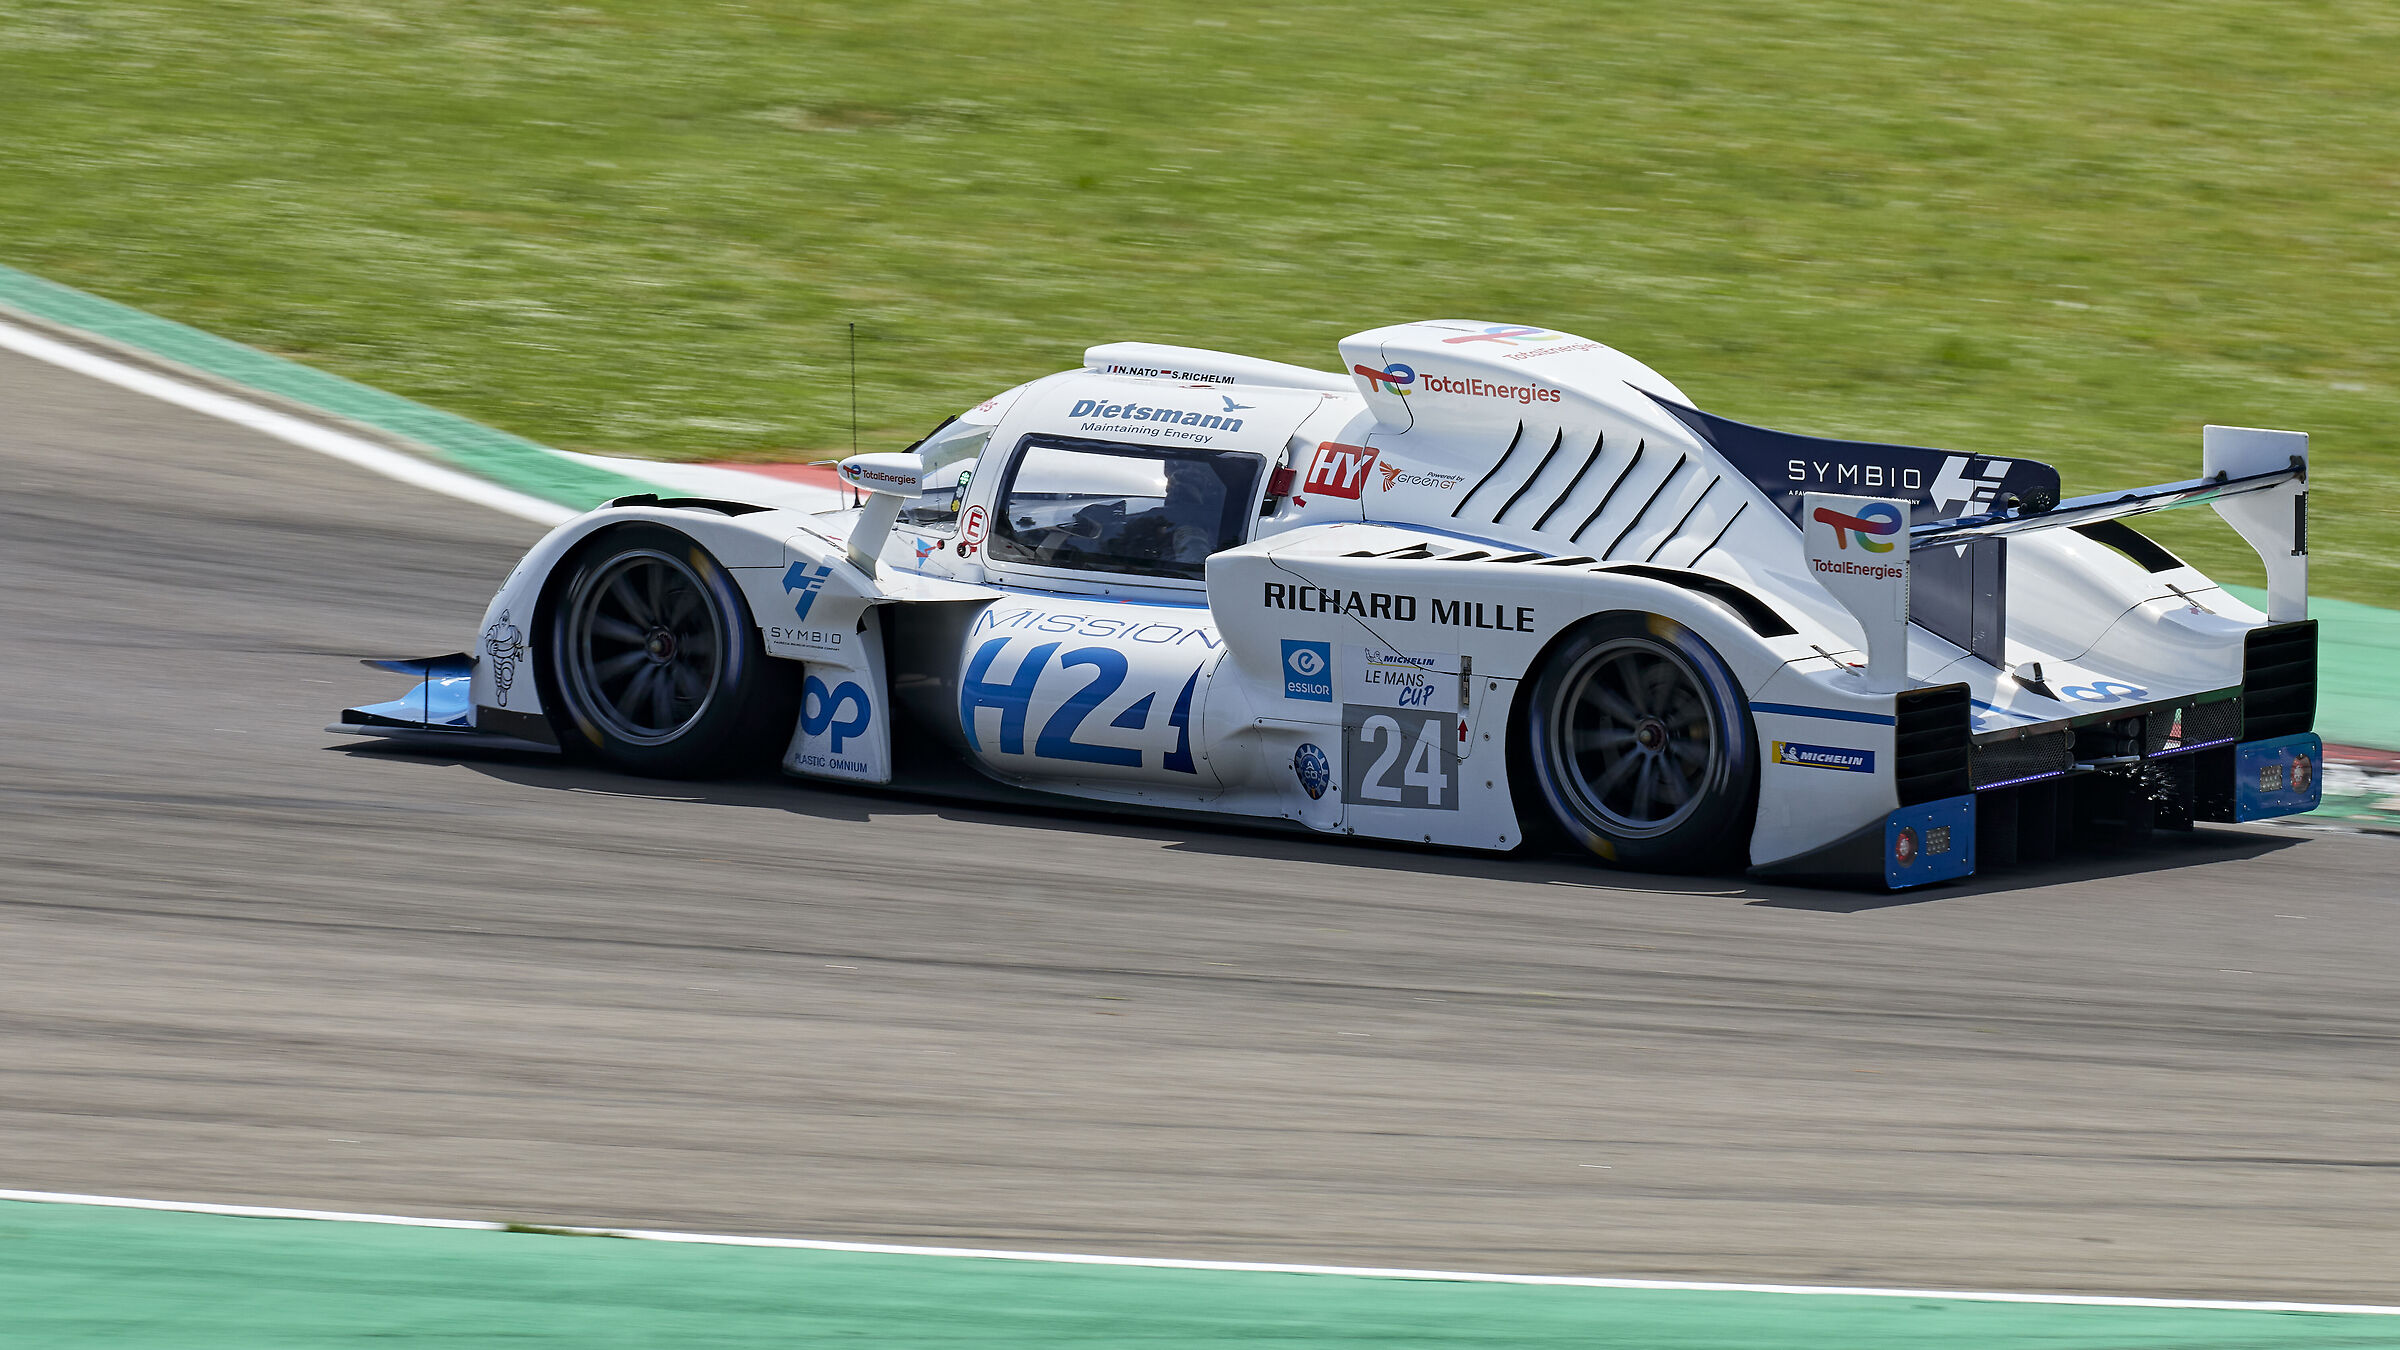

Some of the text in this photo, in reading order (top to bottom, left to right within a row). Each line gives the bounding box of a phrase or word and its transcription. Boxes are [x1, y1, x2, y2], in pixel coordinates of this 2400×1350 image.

[1117, 366, 1235, 385] N.NATO S.RICHELMI
[1419, 373, 1561, 405] TotalEnergies
[1068, 399, 1244, 433] Dietsmann
[1080, 423, 1213, 443] Maintaining Energy
[862, 469, 917, 486] TotalEnergies
[1309, 449, 1374, 489] HY
[1427, 471, 1457, 480] Powered
[1788, 459, 1921, 489] SYMBIO
[967, 511, 983, 538] E
[1813, 558, 1903, 580] TotalEnergies
[1264, 582, 1535, 633] RICHARD MILLE
[771, 626, 842, 645] SYMBIO
[974, 609, 1225, 649] MISSION
[1383, 655, 1435, 666] MICHELIN
[1365, 670, 1424, 687] LE MANS
[961, 636, 1206, 774] H24
[1398, 685, 1435, 706] CUP
[795, 753, 868, 773] PLASTIC OMNIUM
[1360, 714, 1448, 806] 24
[1800, 751, 1864, 766] MICHELIN
